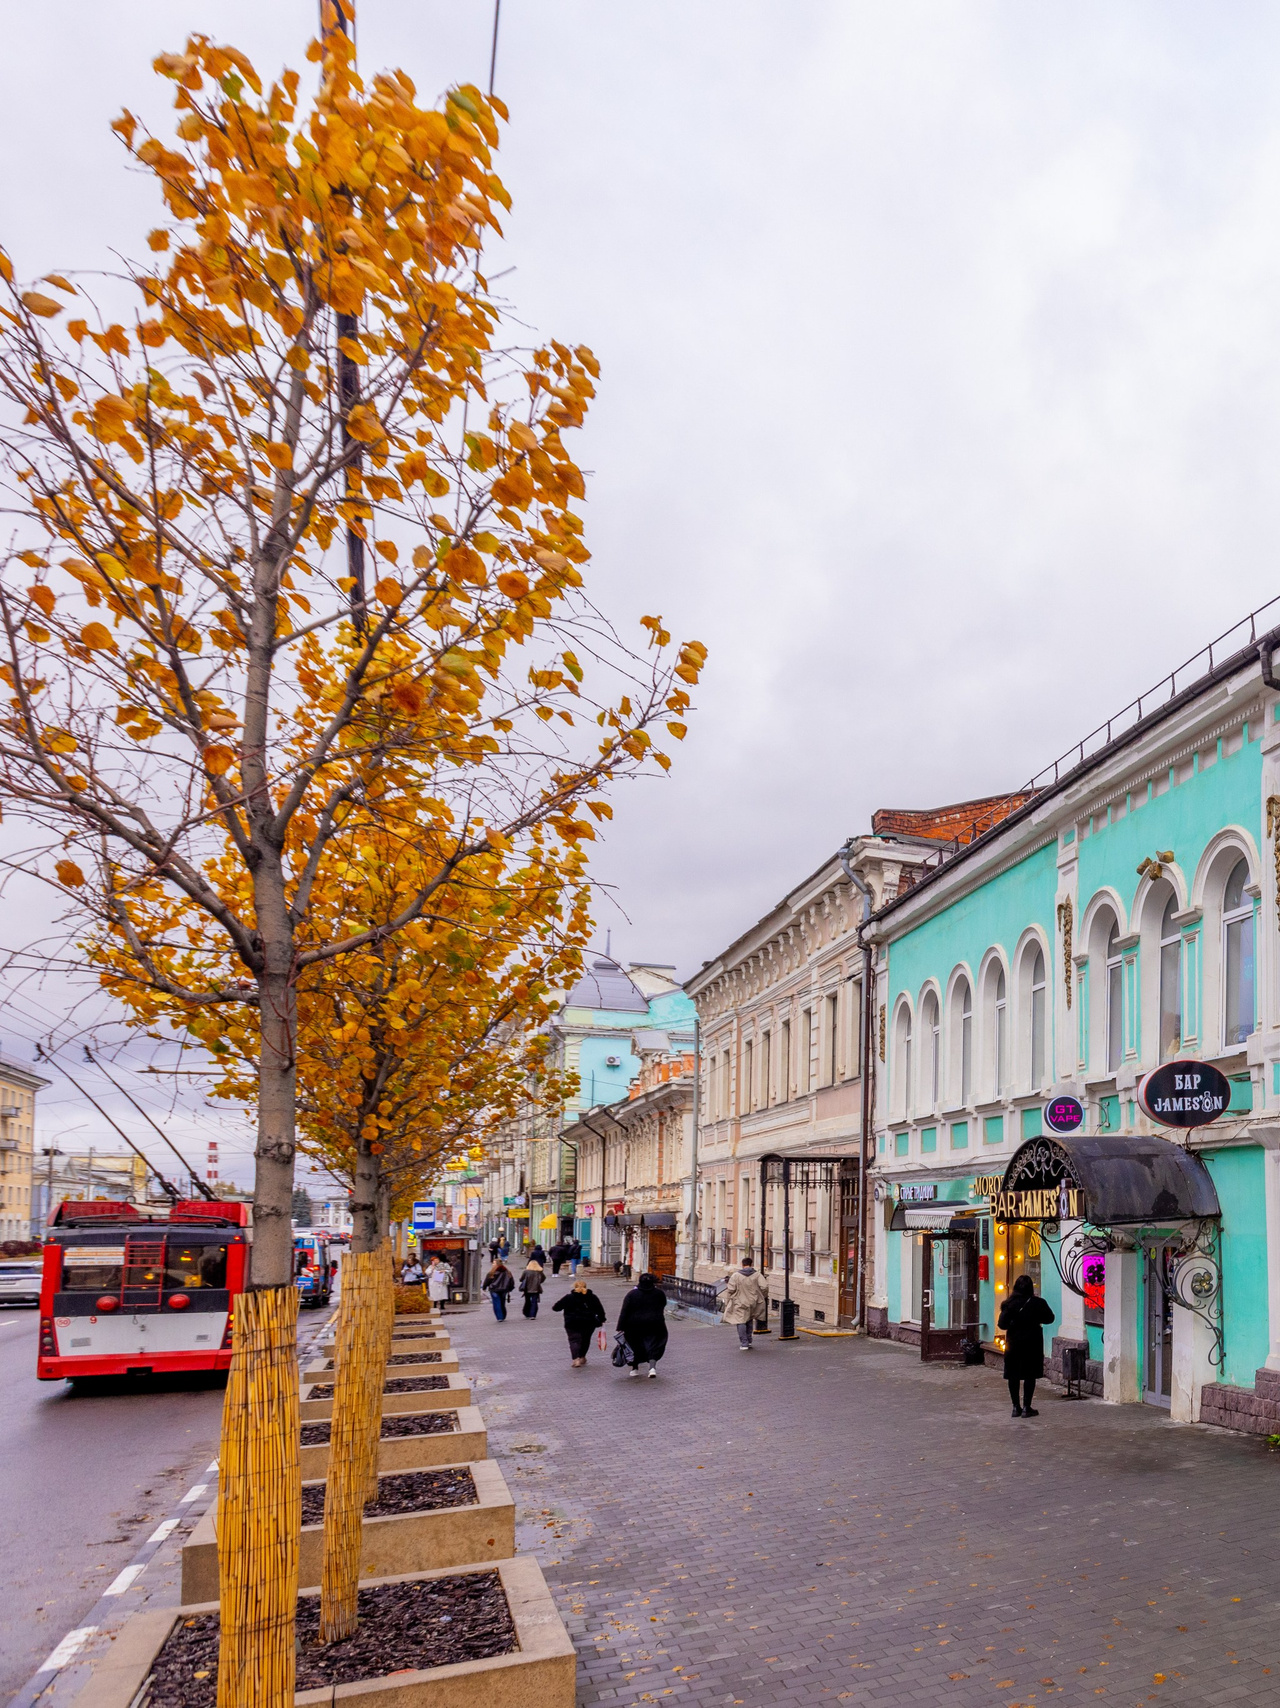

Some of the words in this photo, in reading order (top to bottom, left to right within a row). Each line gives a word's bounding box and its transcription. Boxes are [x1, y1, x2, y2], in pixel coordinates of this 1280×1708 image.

[1174, 1074, 1201, 1090] БАР
[1154, 1091, 1223, 1113] JAMES'ON
[1055, 1105, 1076, 1114] GT
[1050, 1114, 1081, 1123] VAPE
[989, 1192, 1016, 1218] BAR
[90, 1316, 97, 1324] 9
